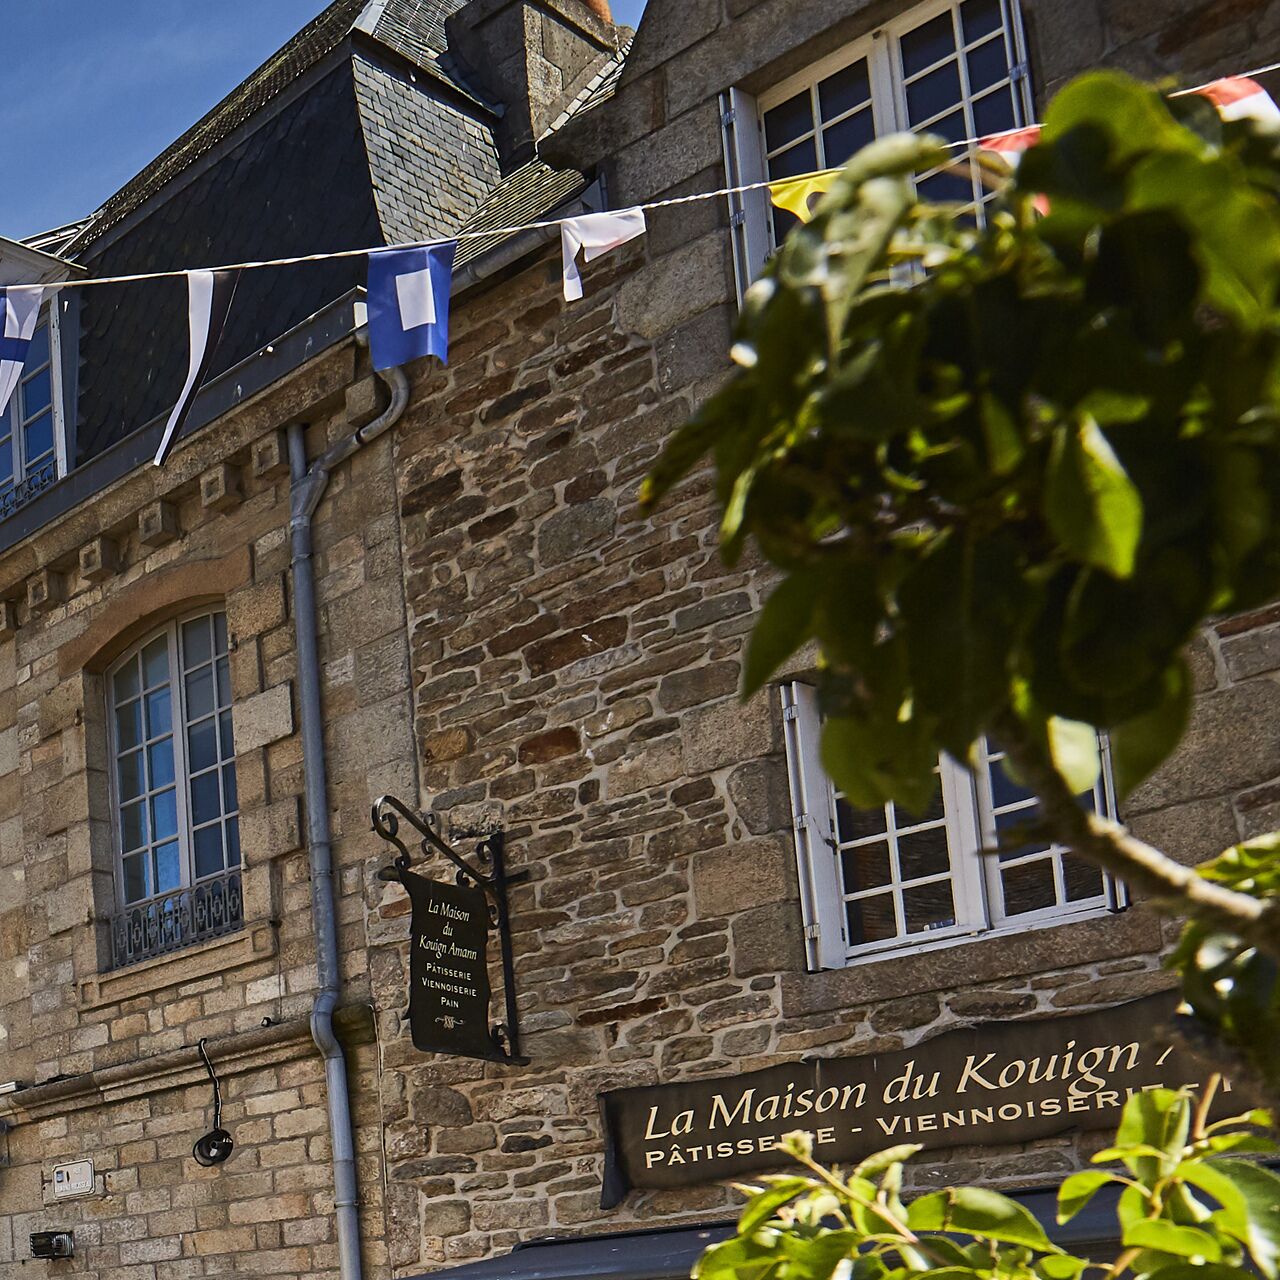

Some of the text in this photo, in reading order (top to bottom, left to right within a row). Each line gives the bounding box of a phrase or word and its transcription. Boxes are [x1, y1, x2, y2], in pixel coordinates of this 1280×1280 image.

[428, 899, 470, 922] La Maison
[442, 921, 454, 937] du
[419, 935, 478, 961] Kouign Amann
[421, 977, 477, 997] VIENNOISERIE
[440, 997, 459, 1008] PAIN
[644, 1105, 695, 1141] La
[707, 1083, 868, 1131] Maison
[882, 1060, 939, 1104] du
[955, 1040, 1140, 1099] Kouign
[645, 1126, 836, 1170] PÂTISSEE
[876, 1082, 1164, 1137] VIENNOISERI
